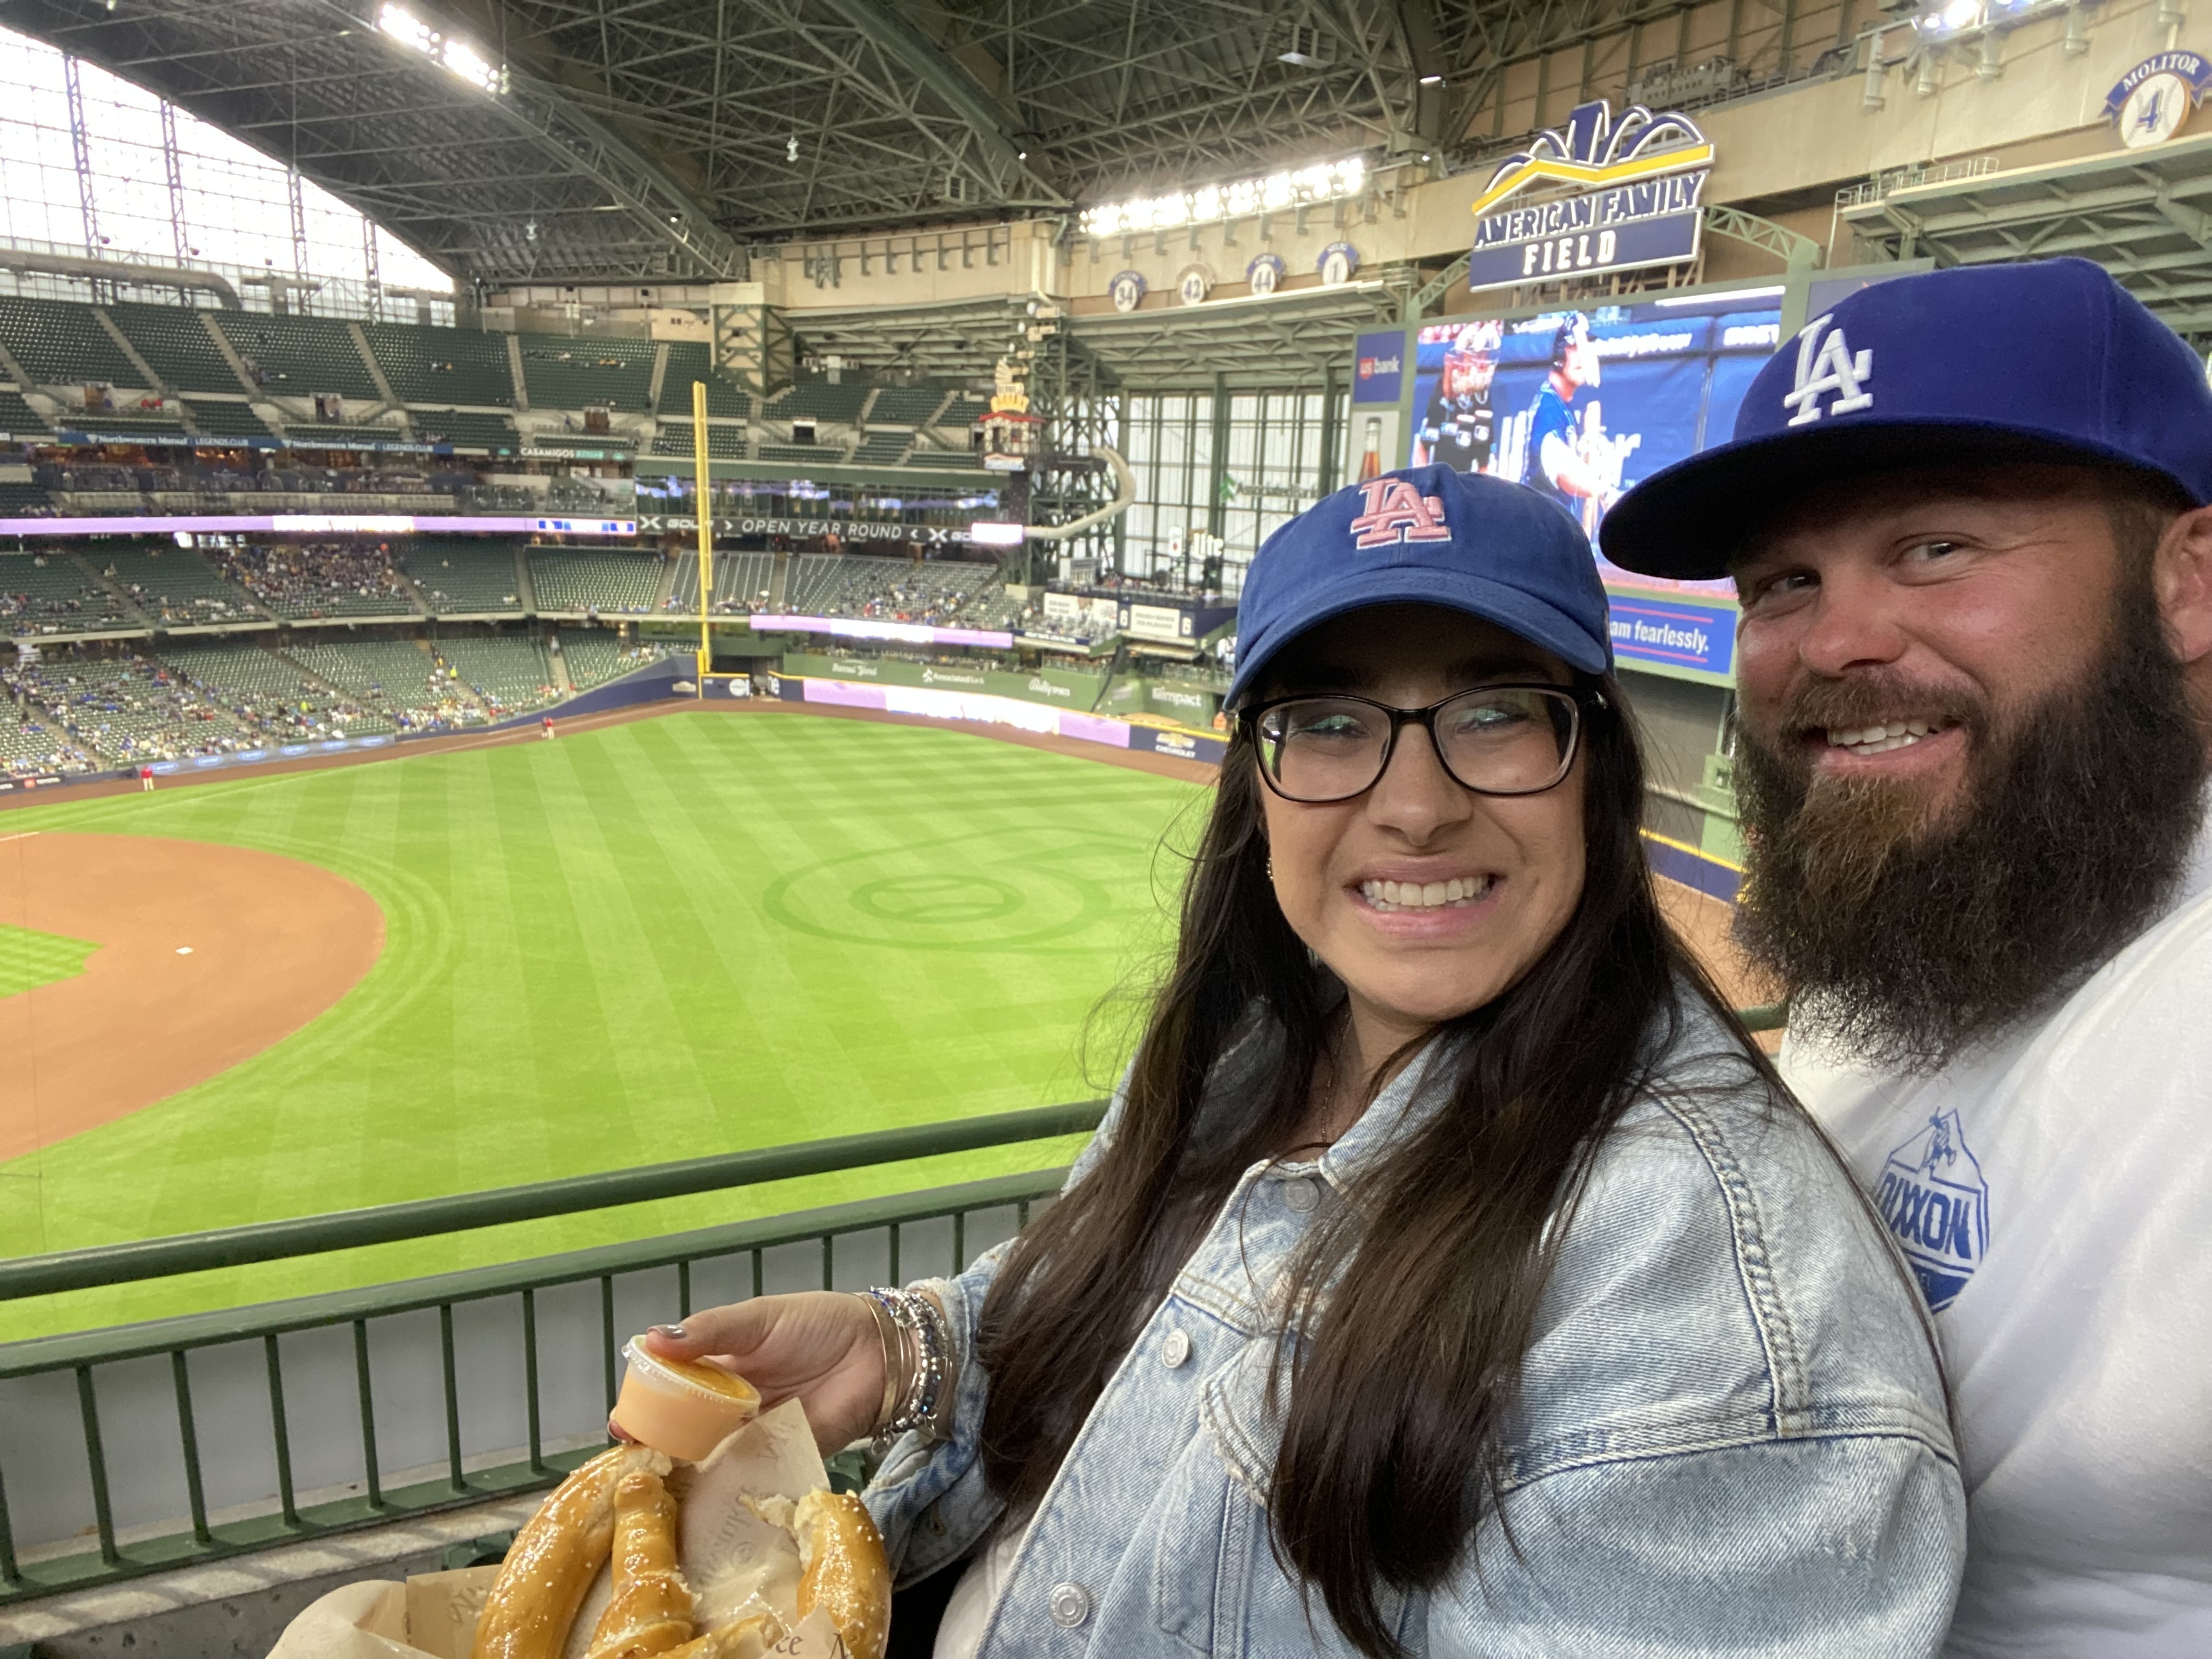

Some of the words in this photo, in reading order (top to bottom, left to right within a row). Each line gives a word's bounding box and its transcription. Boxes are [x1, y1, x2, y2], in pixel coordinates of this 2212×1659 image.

[2123, 54, 2200, 92] MOLITOR
[2136, 88, 2163, 133] 4
[1475, 195, 1596, 249] AMERICAN
[1601, 172, 1707, 224] FAMILY
[1523, 229, 1617, 275] FIELD
[1784, 312, 1874, 426] LA
[521, 447, 575, 459] CASAMIGOS
[741, 520, 791, 533] OPEN
[797, 521, 841, 535] YEAR
[848, 523, 902, 539] ROUND
[1350, 477, 1452, 550] LA
[1634, 619, 1709, 655] fearlessly.
